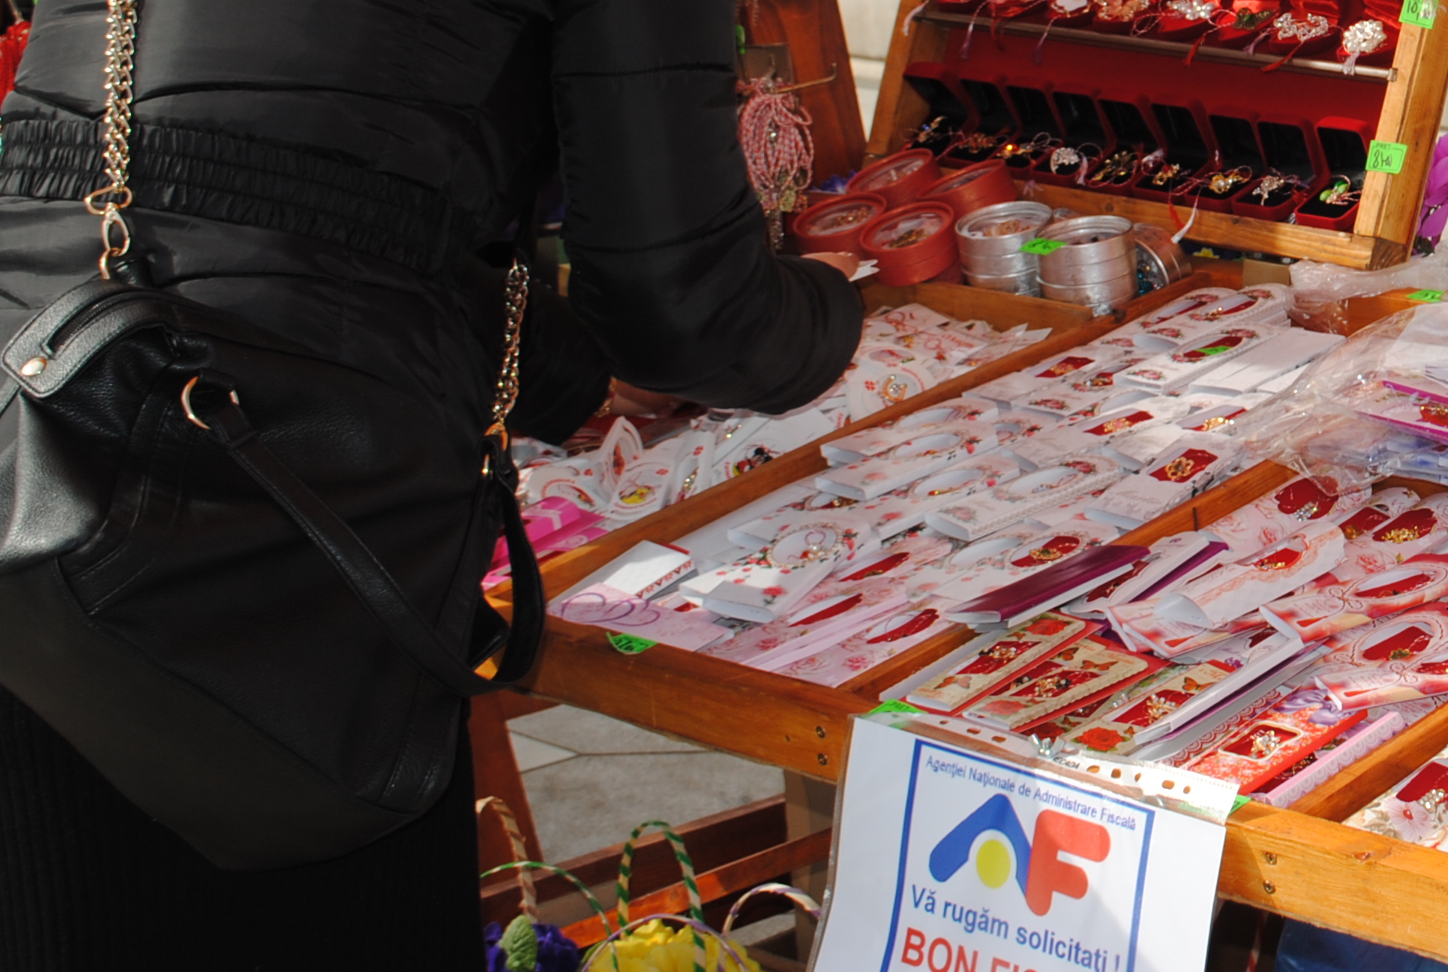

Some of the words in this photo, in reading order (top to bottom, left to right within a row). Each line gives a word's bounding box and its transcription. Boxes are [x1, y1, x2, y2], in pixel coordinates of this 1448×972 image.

[1018, 782, 1031, 798] de
[1033, 787, 1098, 819] Administrare
[1100, 807, 1137, 831] Fiscală
[911, 884, 937, 914] Vă
[942, 900, 1009, 940] rugăm
[901, 926, 979, 972] BON
